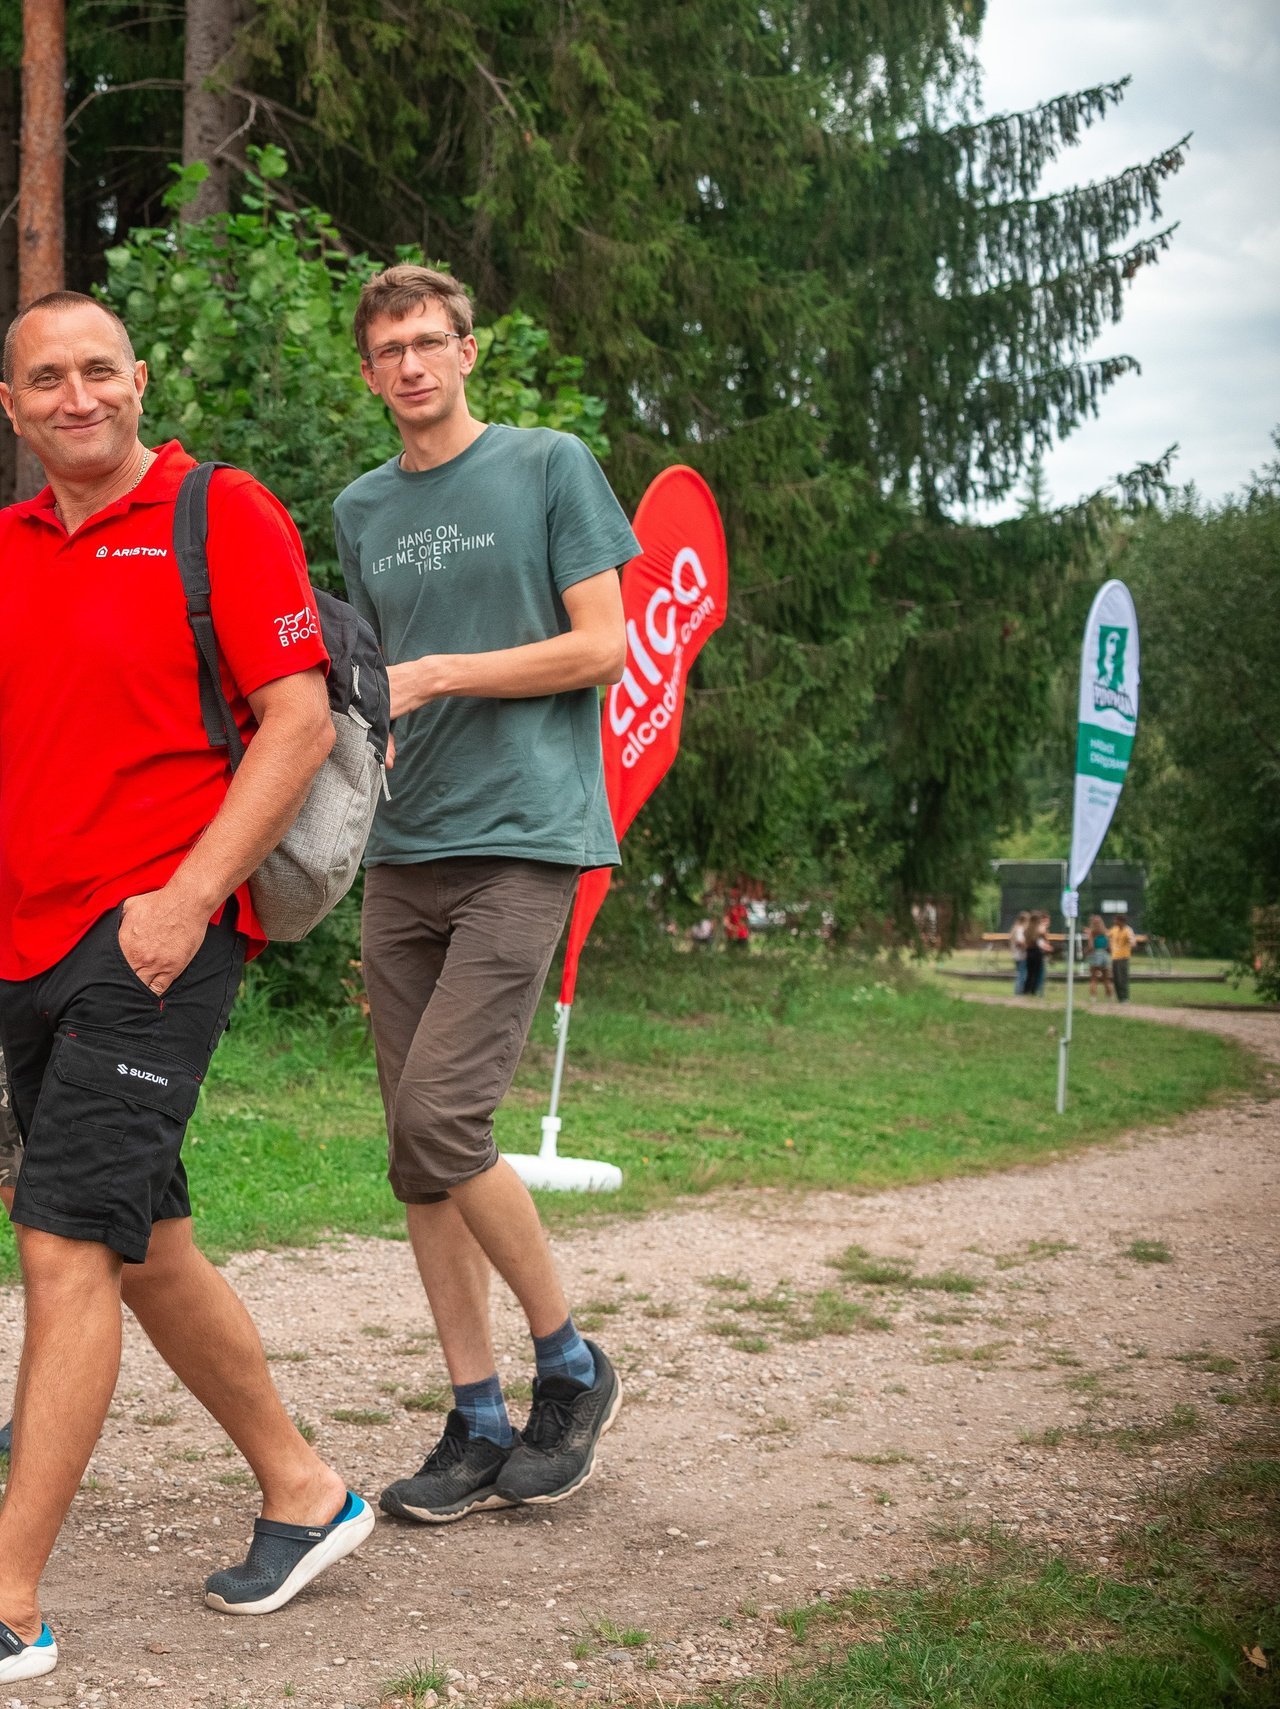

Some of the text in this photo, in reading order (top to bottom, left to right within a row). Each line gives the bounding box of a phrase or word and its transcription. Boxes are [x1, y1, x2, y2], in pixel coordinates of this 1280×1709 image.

[397, 524, 462, 550] HANG ON.
[111, 547, 167, 557] ARISTON
[372, 532, 495, 575] LET ME OVERTHINK
[273, 614, 299, 635] 25
[129, 1068, 169, 1087] SUZUKI
